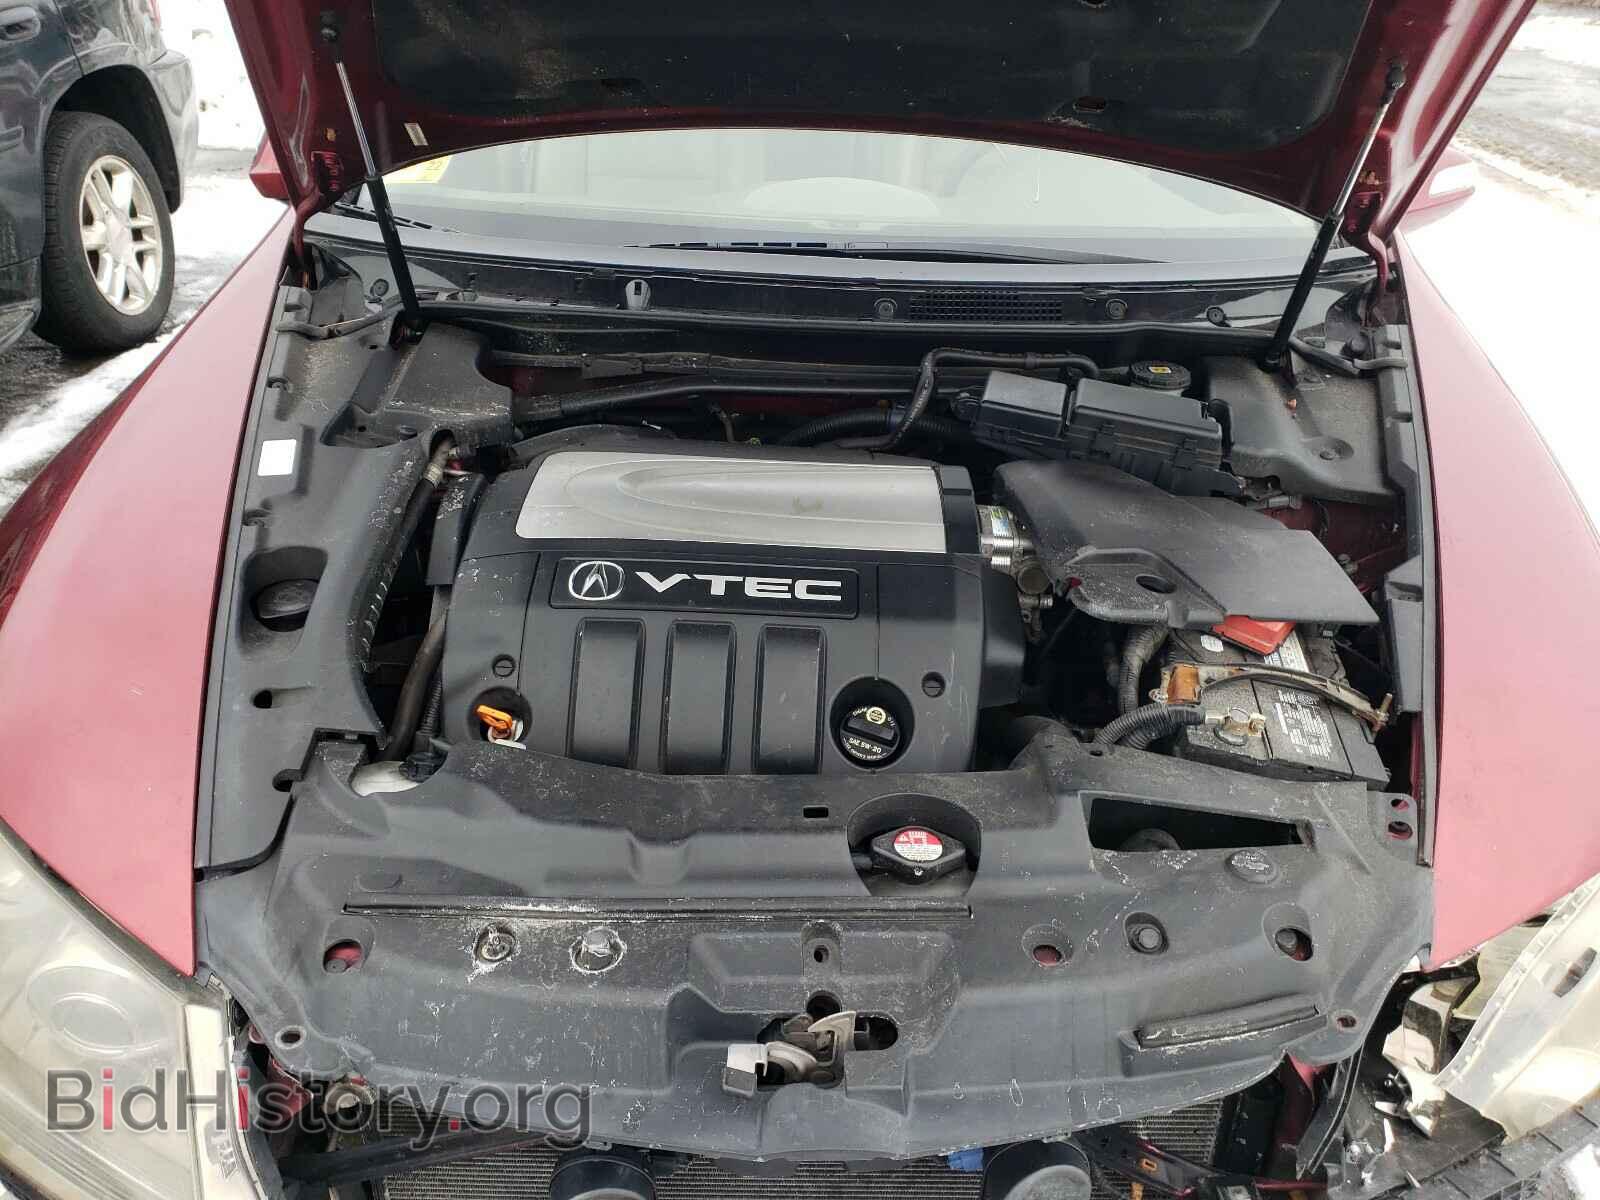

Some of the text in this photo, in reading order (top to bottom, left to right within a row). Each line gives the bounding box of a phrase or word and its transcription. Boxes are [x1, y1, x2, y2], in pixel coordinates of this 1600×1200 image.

[635, 571, 842, 601] VTEC
[848, 737, 861, 747] SAE
[861, 741, 882, 754] 5W-20
